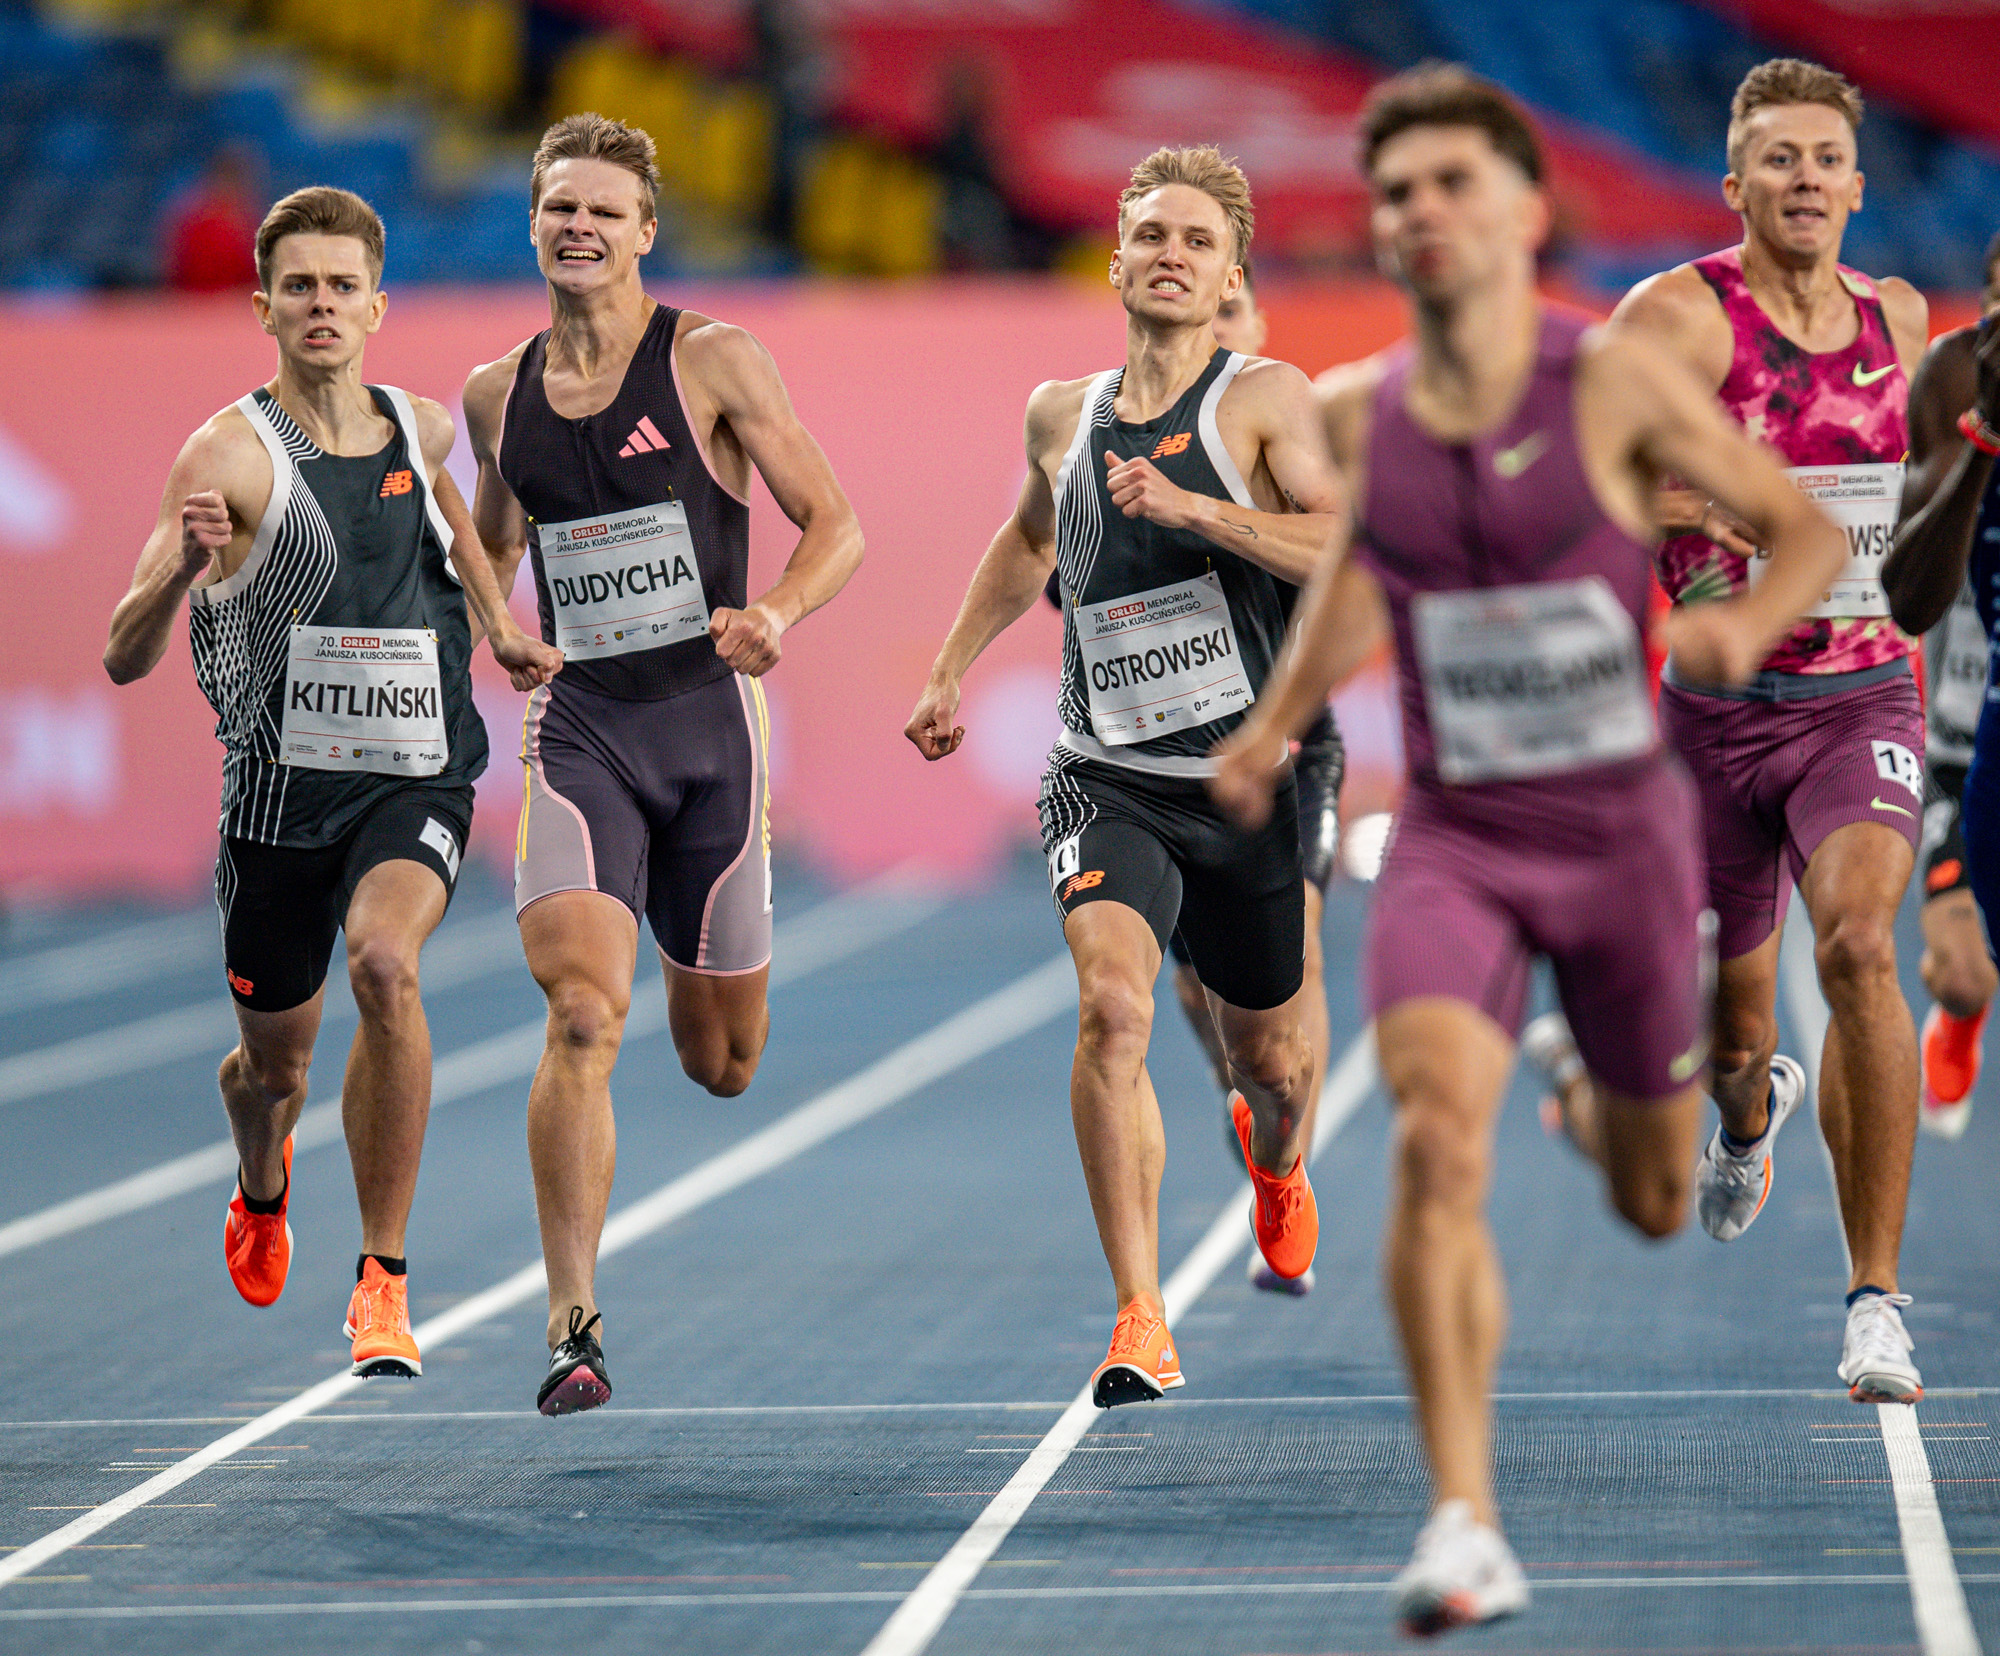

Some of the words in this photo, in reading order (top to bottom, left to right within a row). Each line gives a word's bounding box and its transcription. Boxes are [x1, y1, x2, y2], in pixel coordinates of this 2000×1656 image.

[555, 531, 571, 543] 70.
[573, 525, 606, 539] ORLEN
[609, 514, 658, 532] MEMORIAŁ
[556, 541, 590, 553] JANUSZA
[592, 525, 664, 547] KUSOCIŃSKIEGO
[552, 554, 696, 607] DUDYCHA
[1092, 612, 1108, 624] 70.
[1109, 603, 1144, 619] ORLEN
[1146, 590, 1195, 610] MEMORIAŁ
[1095, 621, 1128, 635] JANUSZA
[1129, 600, 1201, 627] KUSOCIŃSKIEGO
[315, 649, 357, 659] JANUSZA
[360, 650, 423, 661] KUSOCIŃSKIEGO
[320, 636, 338, 648] 70.
[342, 637, 379, 648] ORLEN
[382, 638, 420, 648] MEMORIAŁ
[1091, 626, 1232, 692] OSTROWSKI
[291, 680, 438, 719] KITLIŃSKI
[1226, 687, 1245, 699] FUEL
[423, 752, 443, 761] FUEL
